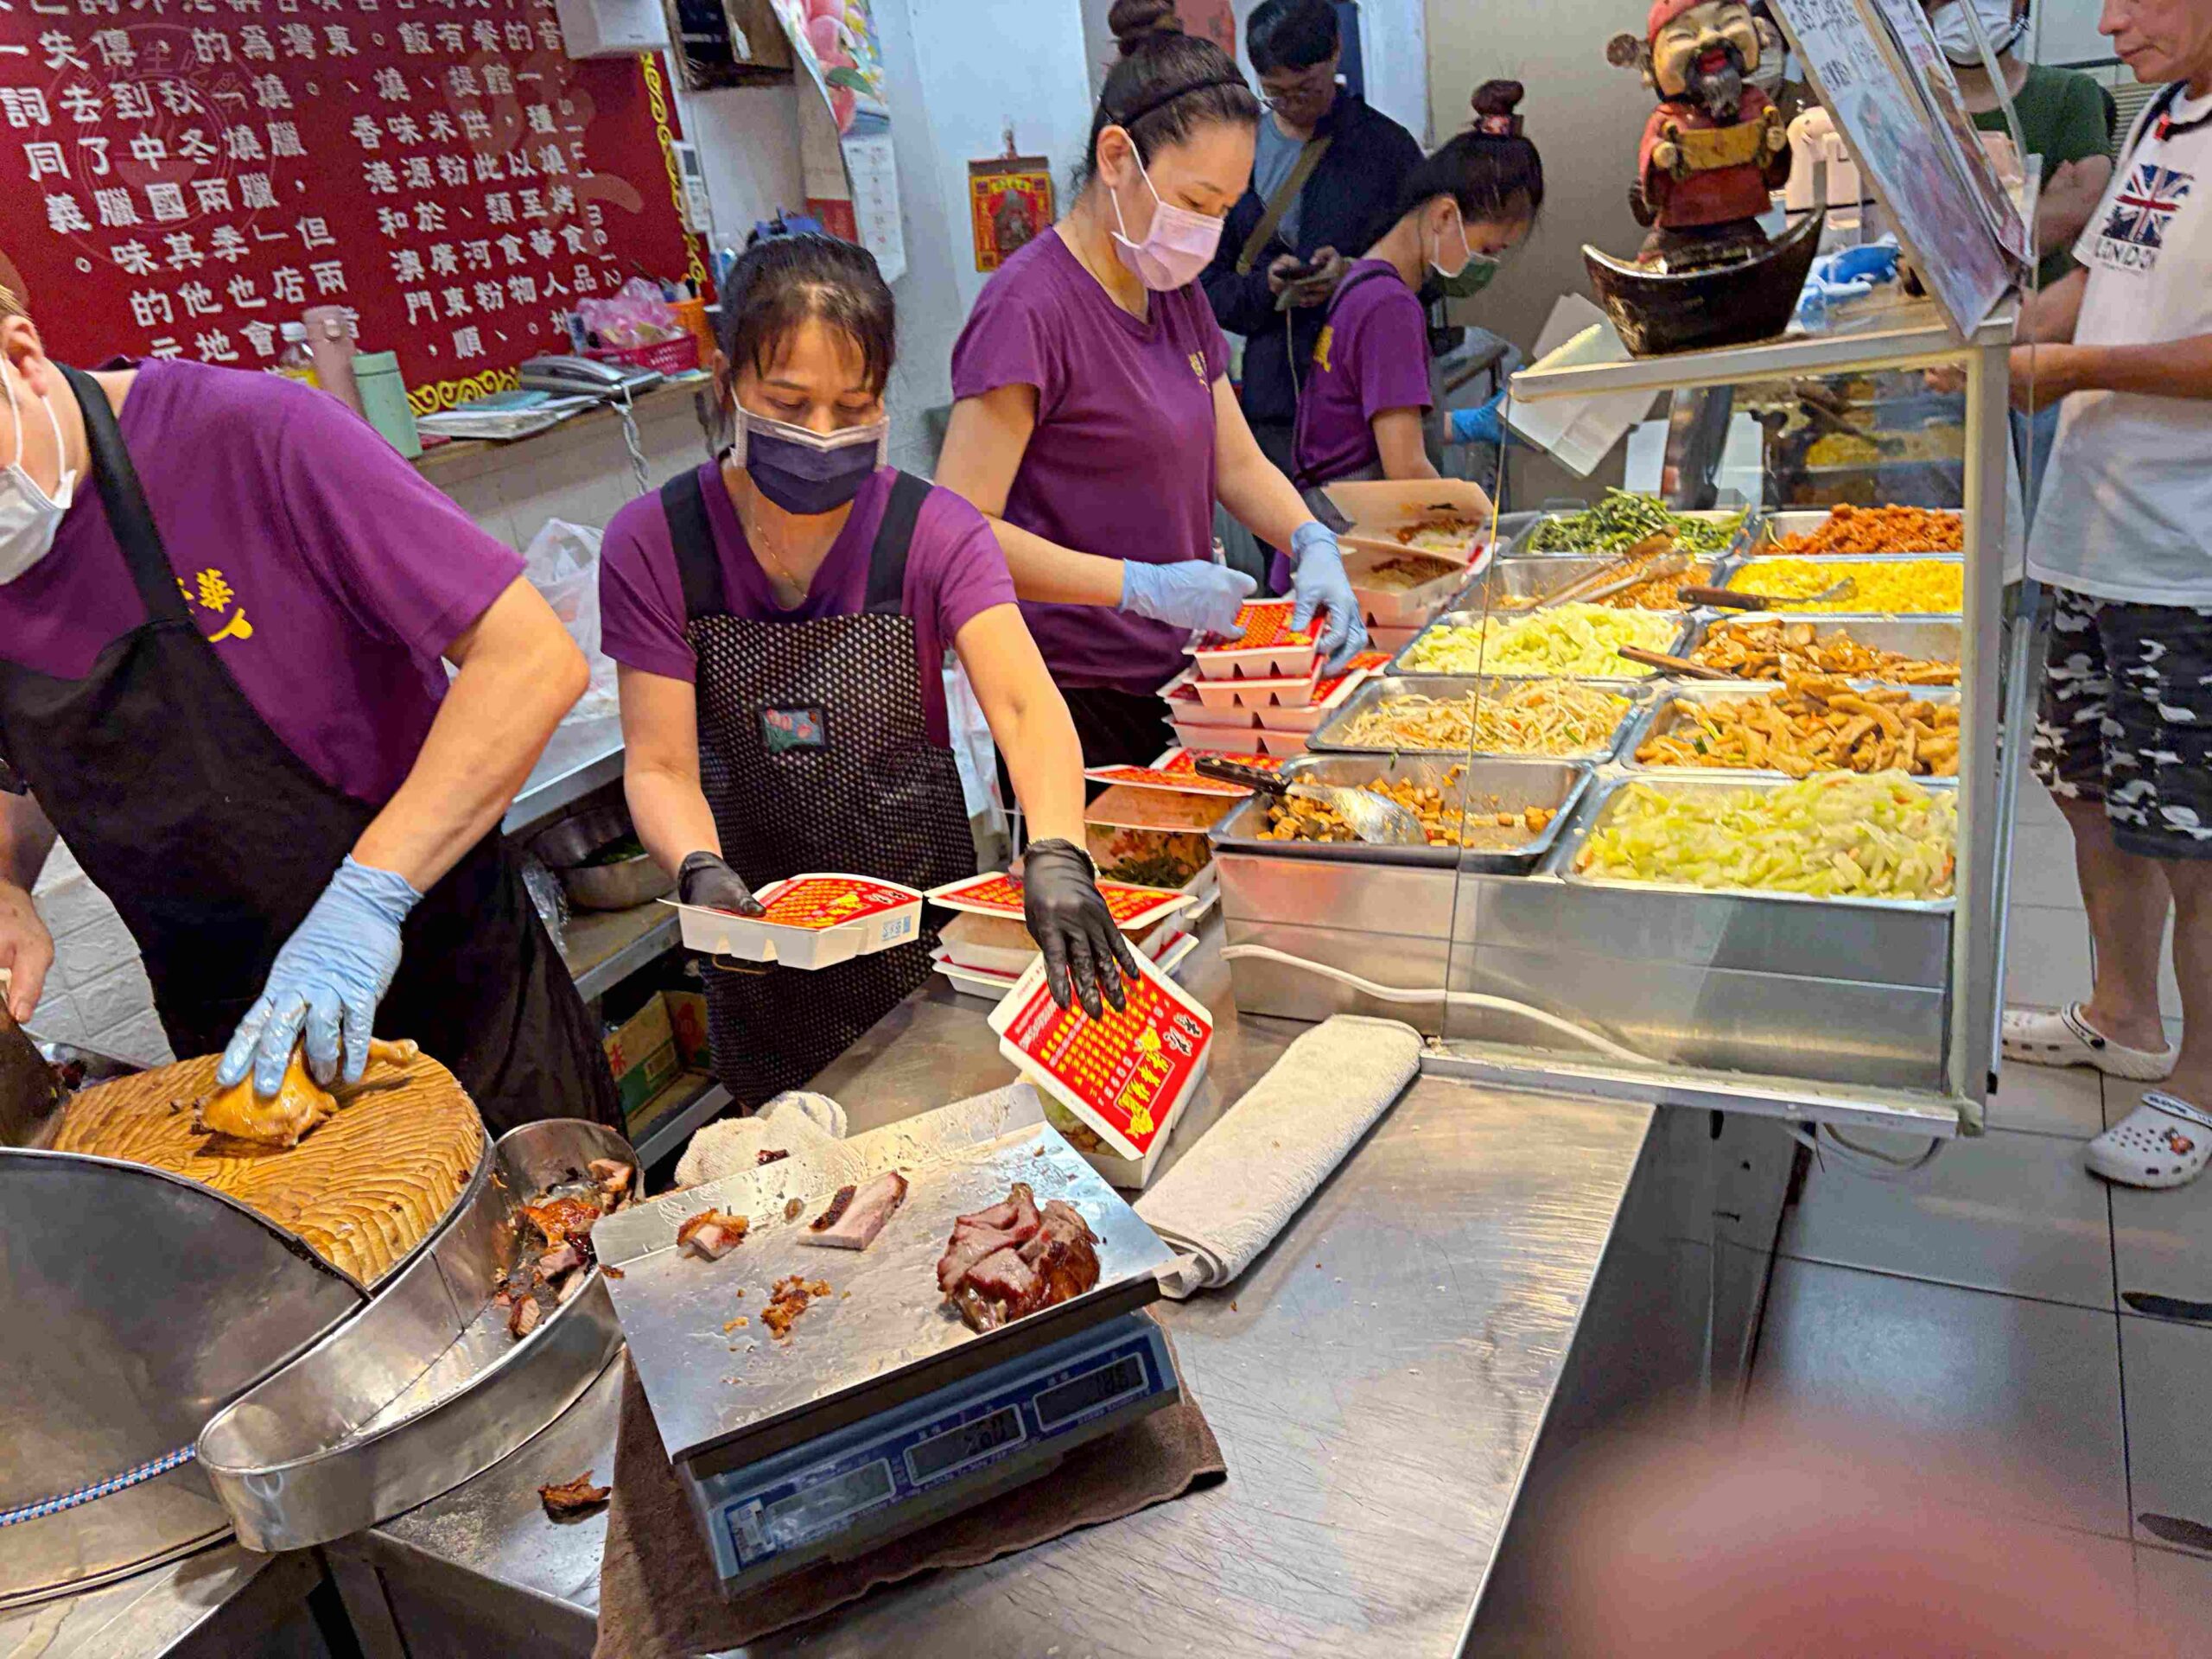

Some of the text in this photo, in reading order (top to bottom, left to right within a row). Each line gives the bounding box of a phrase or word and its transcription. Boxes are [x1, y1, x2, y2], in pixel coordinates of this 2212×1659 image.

[130, 0, 285, 373] ，秋冬兩季也會
[505, 0, 598, 294] 的一種燒烤食品
